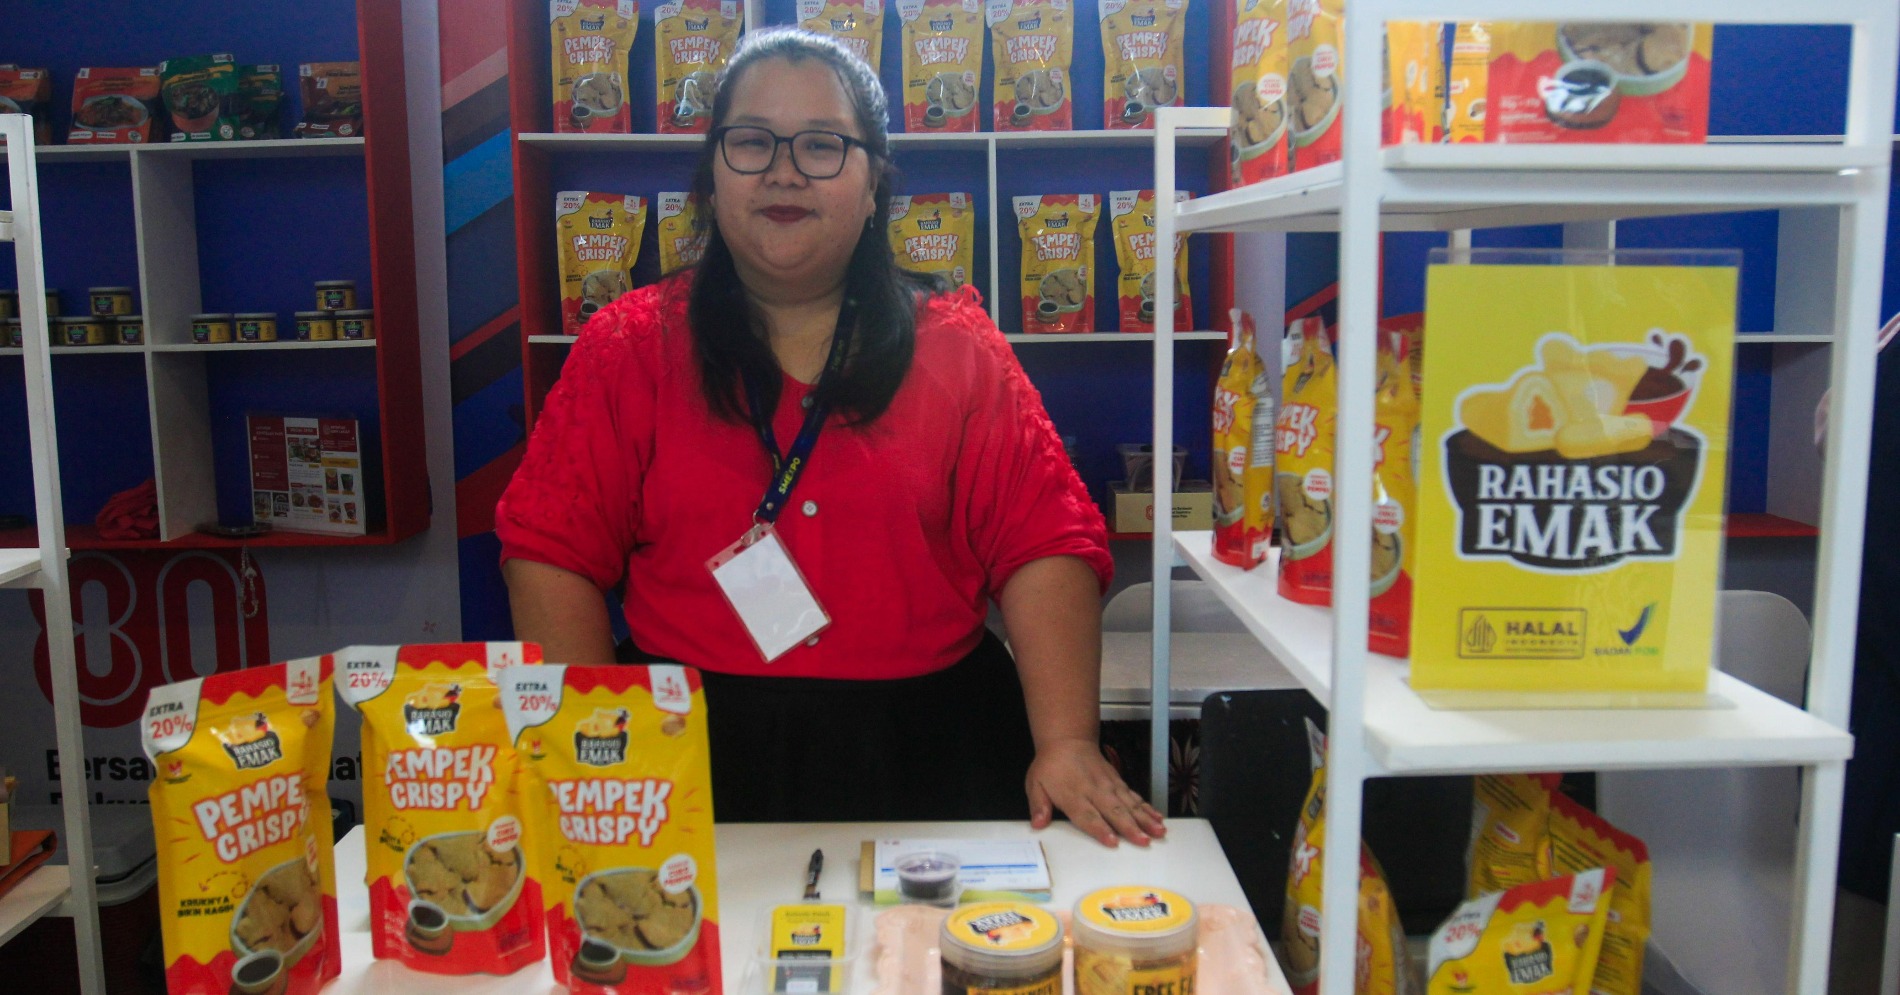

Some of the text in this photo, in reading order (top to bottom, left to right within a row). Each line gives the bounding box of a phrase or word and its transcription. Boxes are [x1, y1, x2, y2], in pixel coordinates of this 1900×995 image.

[564, 36, 616, 54] PEMPEK
[669, 36, 721, 54] PEMPEK
[914, 38, 970, 54] PEMPEK
[1006, 35, 1058, 54] PEMPEK
[1116, 32, 1169, 51] PEMPEK
[568, 50, 612, 65] CRISPY
[674, 51, 717, 64] CRISPY
[920, 51, 967, 66] CRISPY
[1010, 50, 1054, 64] CRISPY
[1122, 46, 1167, 60] CRISPY
[1019, 207, 1036, 215] 20%
[1116, 201, 1134, 210] 20%
[573, 235, 628, 252] PEMPEK
[904, 235, 959, 253] PEMPEK
[577, 249, 623, 262] CRISPY
[910, 248, 955, 263] CRISPY
[1037, 247, 1079, 262] CRISPY
[1477, 464, 1666, 501] RAHASIO
[1475, 502, 1663, 561] EMAK
[1505, 621, 1579, 637] HALAL
[346, 661, 381, 670] EXTRA
[349, 672, 390, 689] 20%
[516, 682, 548, 692] EXTRA
[150, 701, 184, 718] EXTRA
[519, 695, 558, 712] 20%
[150, 714, 193, 740] 20%
[237, 747, 279, 769] EMAK
[390, 781, 489, 810] CRISPY
[195, 775, 305, 840] PEMPE
[559, 813, 660, 846] CRISPY
